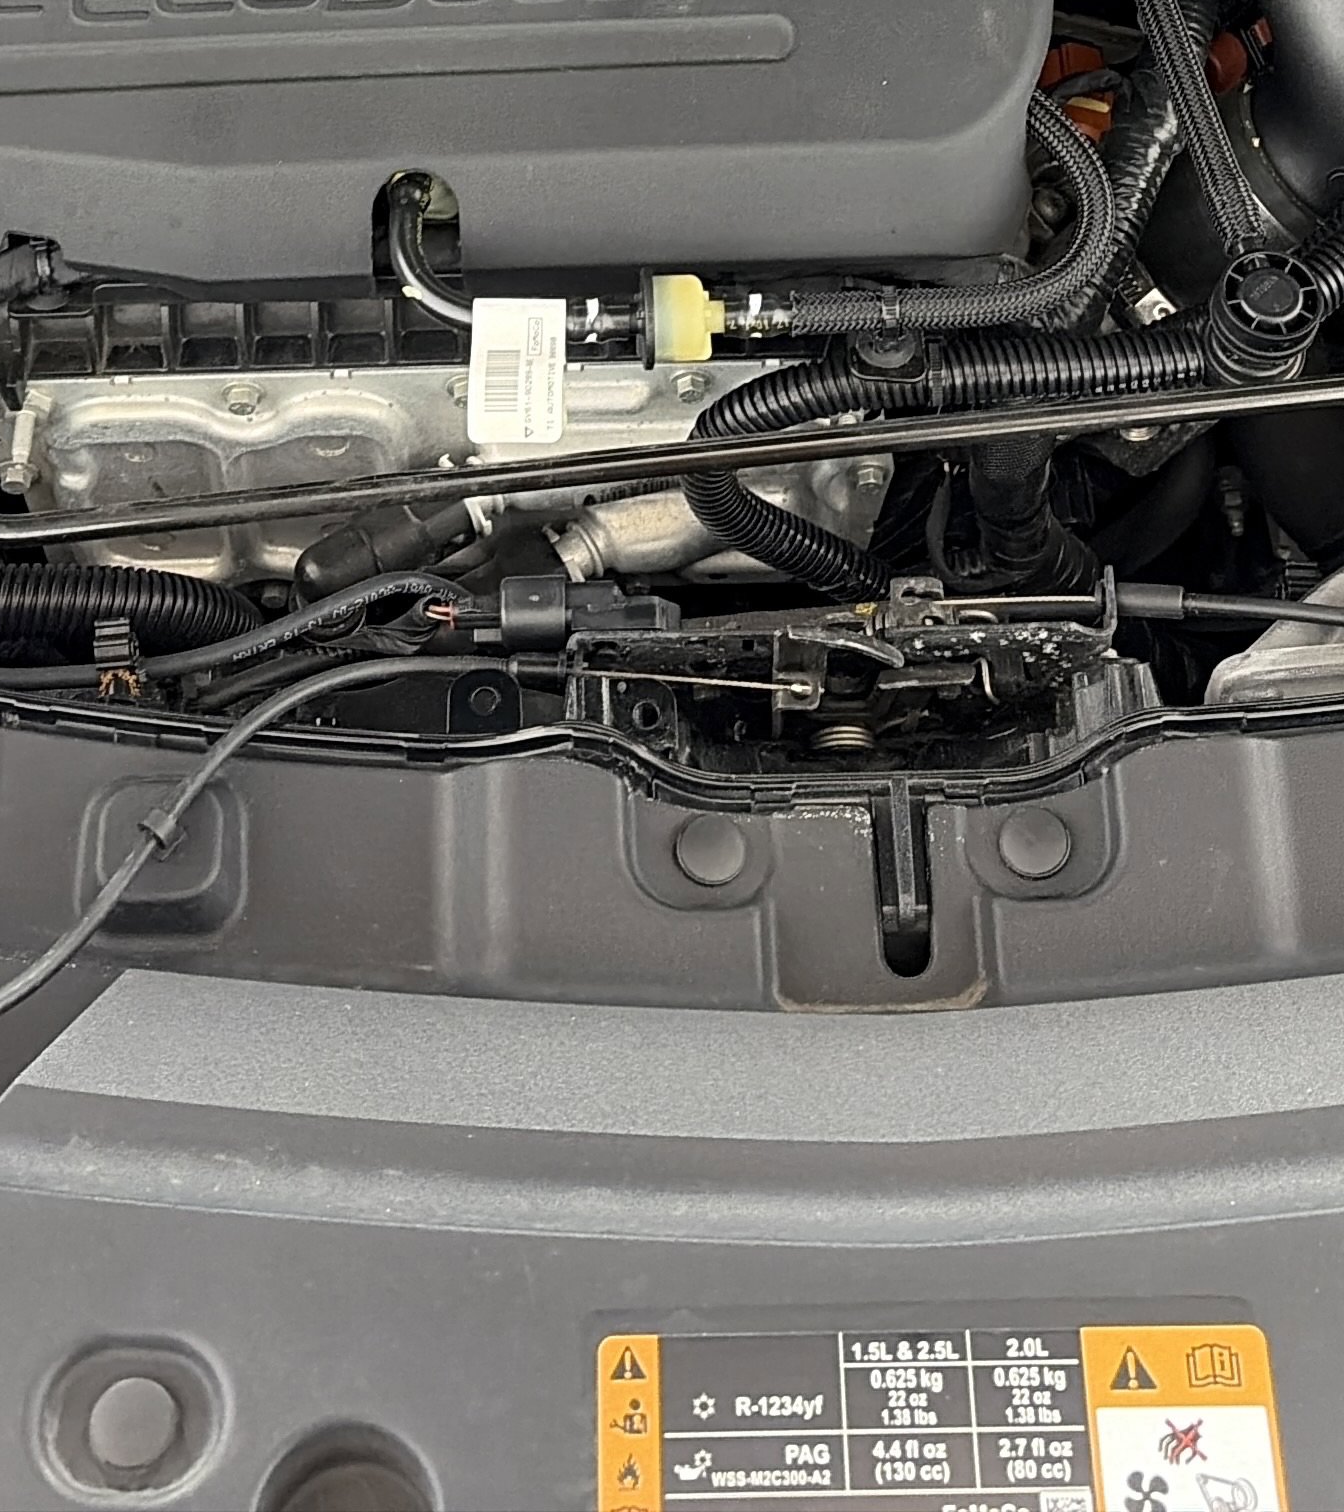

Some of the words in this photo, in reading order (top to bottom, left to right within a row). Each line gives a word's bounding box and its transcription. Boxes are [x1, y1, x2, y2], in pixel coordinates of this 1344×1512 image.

[851, 1340, 894, 1361] 1.5L
[897, 1340, 914, 1361] &
[916, 1339, 961, 1361] 2.5L
[1005, 1336, 1050, 1358] 2.0L
[870, 1368, 917, 1389] 0.625
[919, 1368, 944, 1393] kg
[993, 1366, 1041, 1387] 0.625
[1043, 1366, 1067, 1392] kg
[734, 1394, 825, 1421] R-1234yf
[887, 1389, 907, 1408] 22
[908, 1392, 929, 1408] oz
[1011, 1387, 1031, 1406] 22
[1032, 1390, 1052, 1406] oz
[881, 1408, 912, 1426] 1.38
[913, 1408, 939, 1426] lbs
[1005, 1406, 1036, 1424] 1.38
[1038, 1406, 1063, 1424] lbs
[784, 1443, 832, 1465] PAG
[872, 1439, 903, 1459] 4.4
[904, 1439, 920, 1459] fl
[922, 1442, 948, 1460] oz
[998, 1437, 1028, 1458] 2.7
[1030, 1437, 1046, 1457] fl
[1048, 1440, 1074, 1457] oz
[711, 1469, 832, 1488] WSS-M2C300-A2
[874, 1461, 917, 1486] (130
[919, 1460, 951, 1485] cc)
[1006, 1458, 1038, 1483] (80
[1040, 1458, 1072, 1483] cc)
